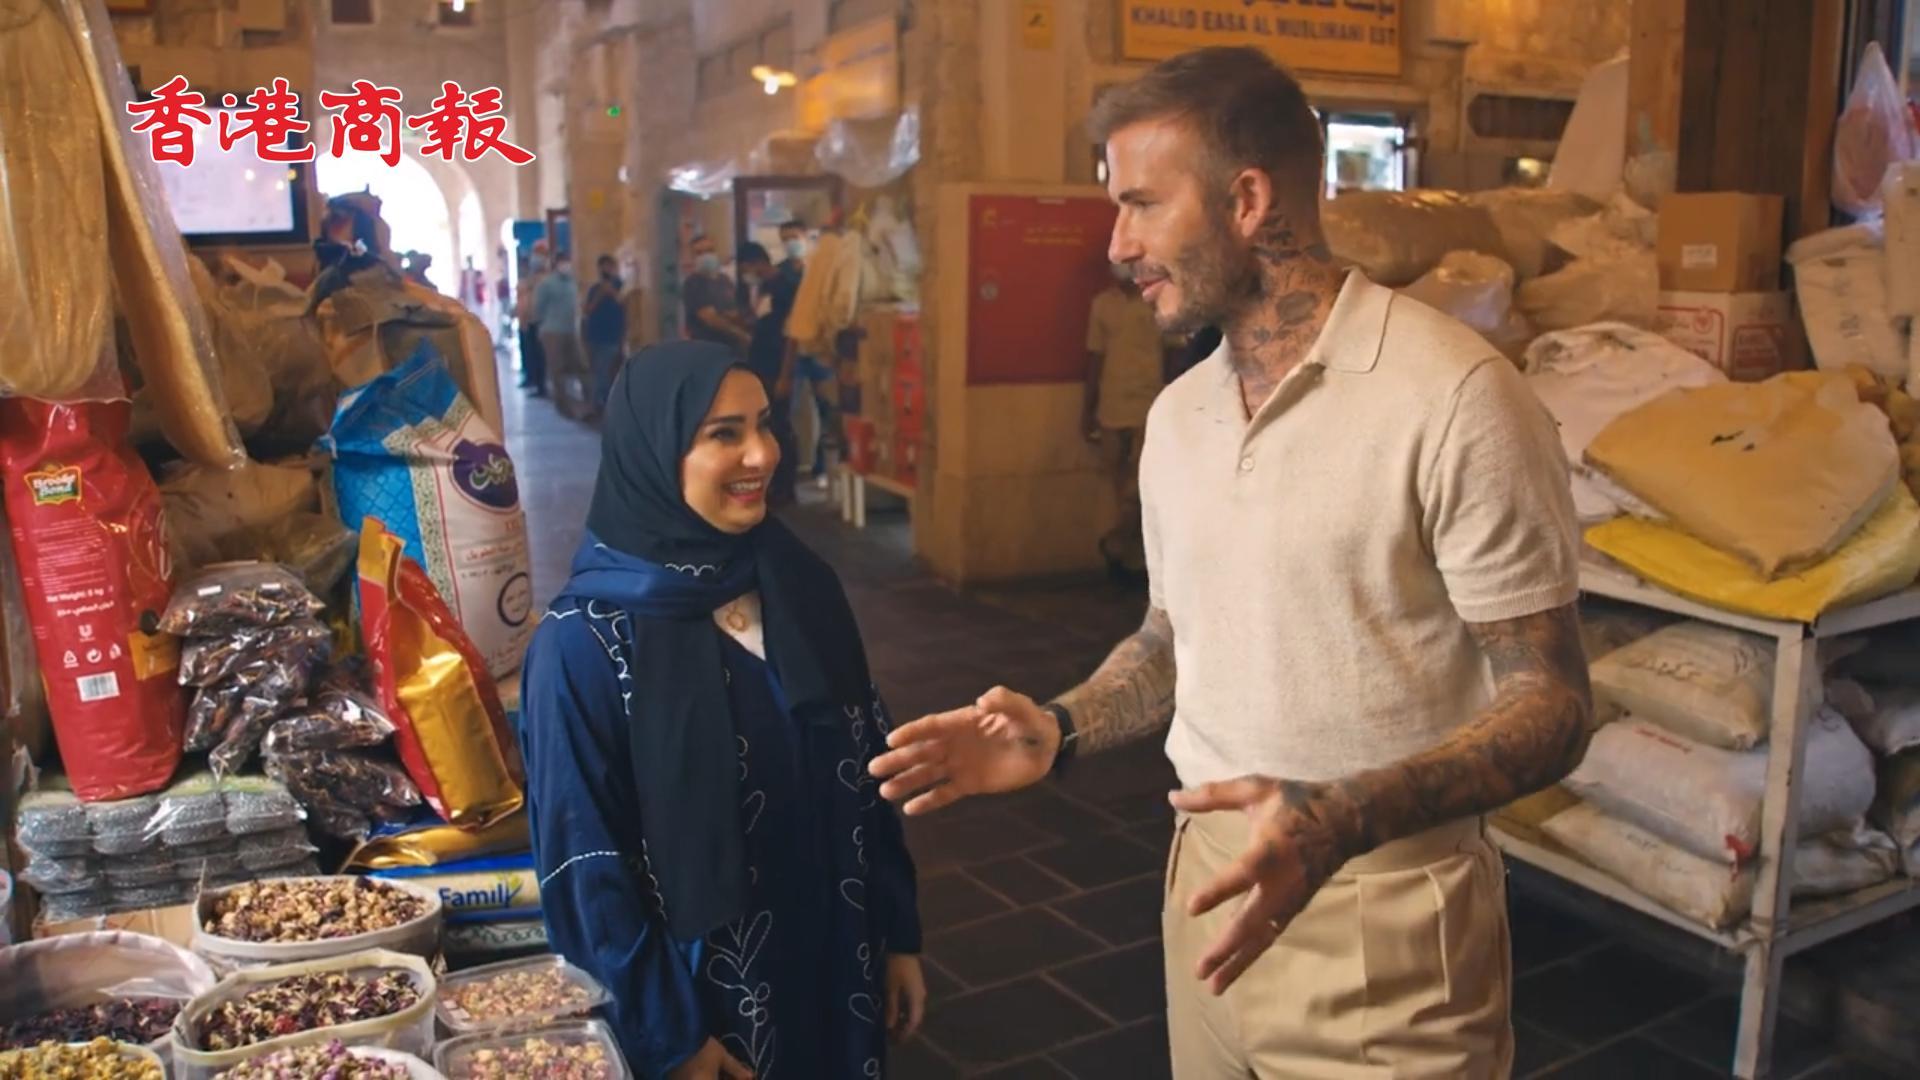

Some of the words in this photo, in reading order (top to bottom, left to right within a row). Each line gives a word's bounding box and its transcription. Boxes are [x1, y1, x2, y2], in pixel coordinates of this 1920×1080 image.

[1130, 7, 1196, 30] KHALID
[1202, 11, 1247, 32] EASA
[1253, 15, 1272, 36] AL
[439, 879, 523, 908] Family
